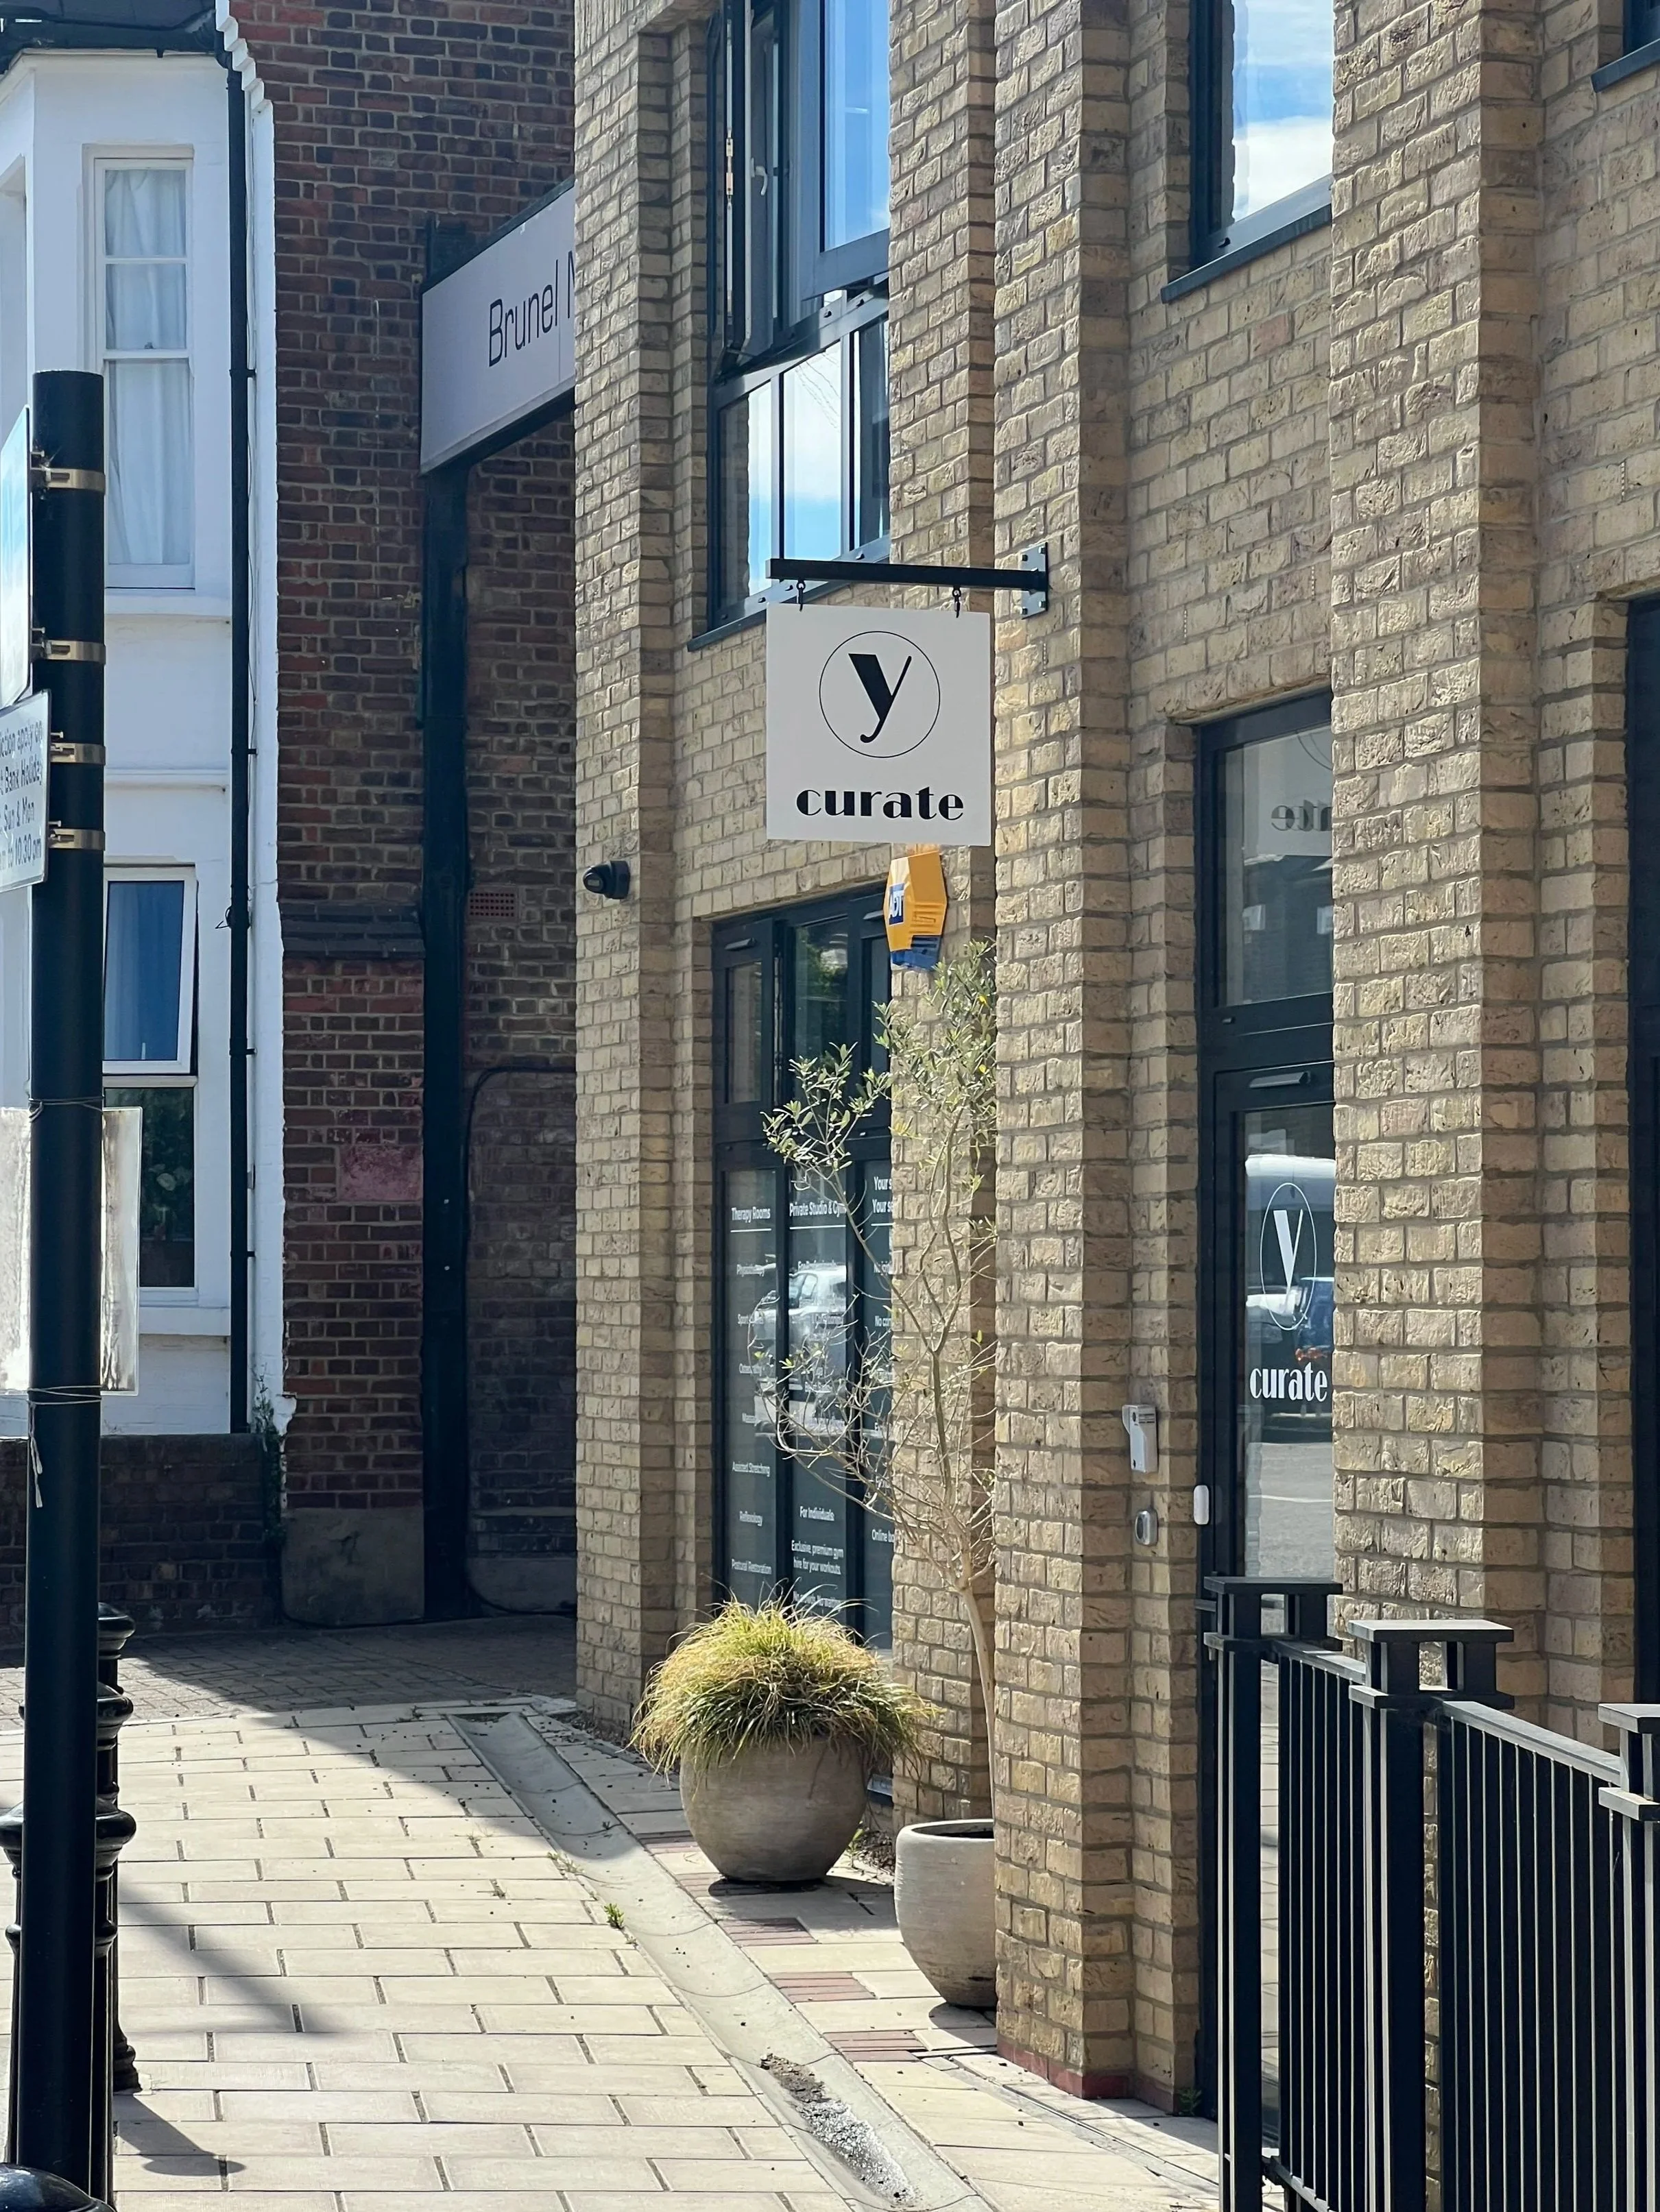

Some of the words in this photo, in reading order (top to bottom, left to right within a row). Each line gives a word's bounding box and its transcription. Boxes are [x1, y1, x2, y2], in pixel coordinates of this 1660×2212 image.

[488, 258, 559, 368] Brunel
[5, 765, 19, 794] Bank
[21, 755, 43, 787] Holiday
[795, 786, 964, 821] curate
[4, 803, 14, 831] Sun
[22, 796, 35, 825] Mon
[889, 890, 904, 919] ADT
[874, 1176, 888, 1191] Your
[789, 1202, 809, 1217] Private
[809, 1201, 827, 1216] Studio
[827, 1201, 832, 1215] &
[871, 1199, 887, 1213] Your
[731, 1207, 751, 1223] Therapy
[752, 1206, 771, 1220] Rooms
[1249, 1362, 1328, 1402] curate
[799, 1505, 808, 1518] For
[871, 1529, 887, 1542] Online
[833, 1548, 844, 1559] gym
[809, 1562, 819, 1573] your
